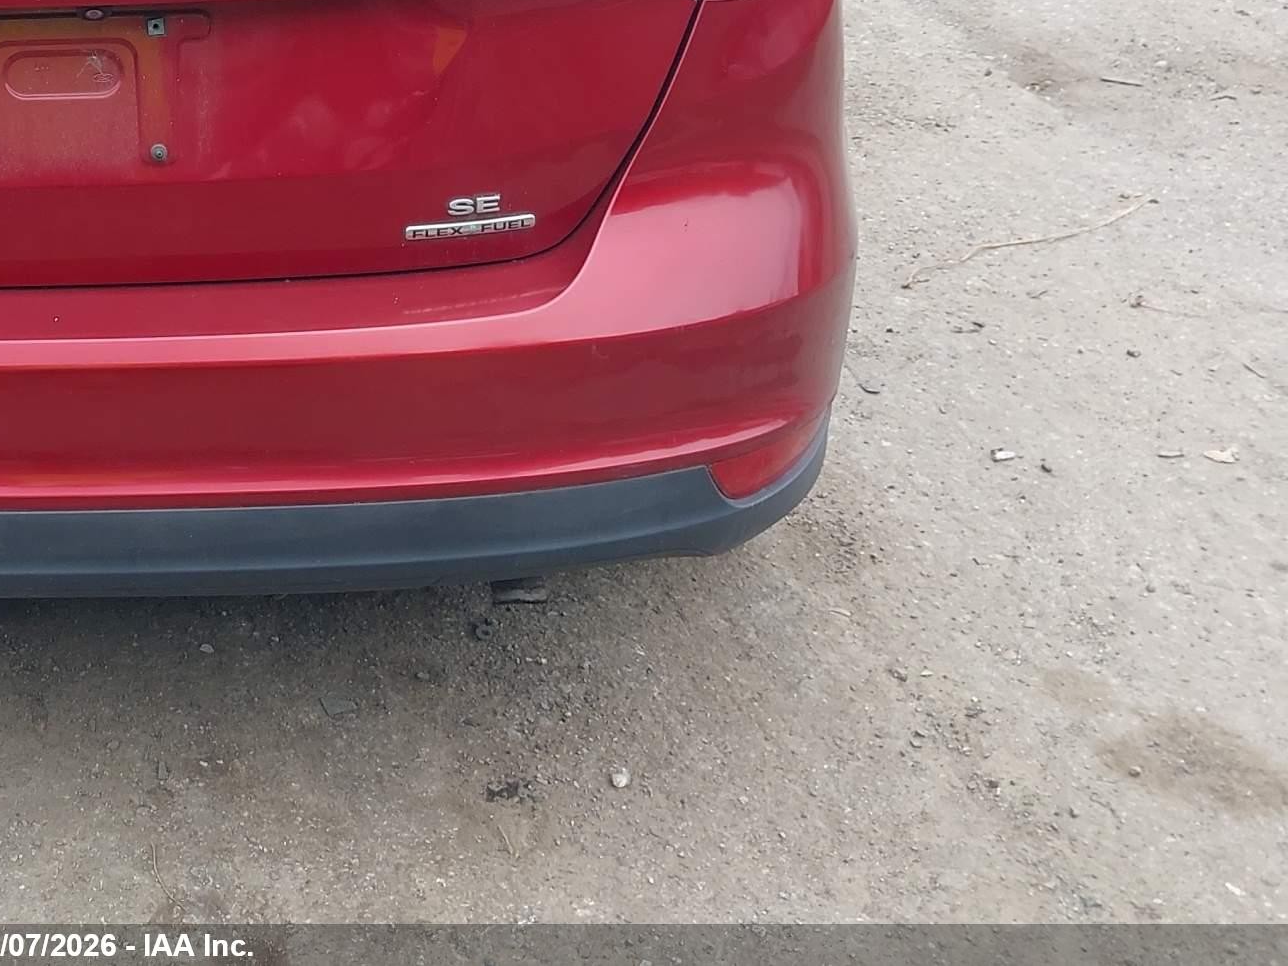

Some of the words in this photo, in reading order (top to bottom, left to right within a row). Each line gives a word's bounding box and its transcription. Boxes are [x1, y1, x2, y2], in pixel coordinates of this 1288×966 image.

[447, 194, 500, 215] SE
[411, 225, 463, 239] FLEX
[480, 218, 531, 233] FUEL
